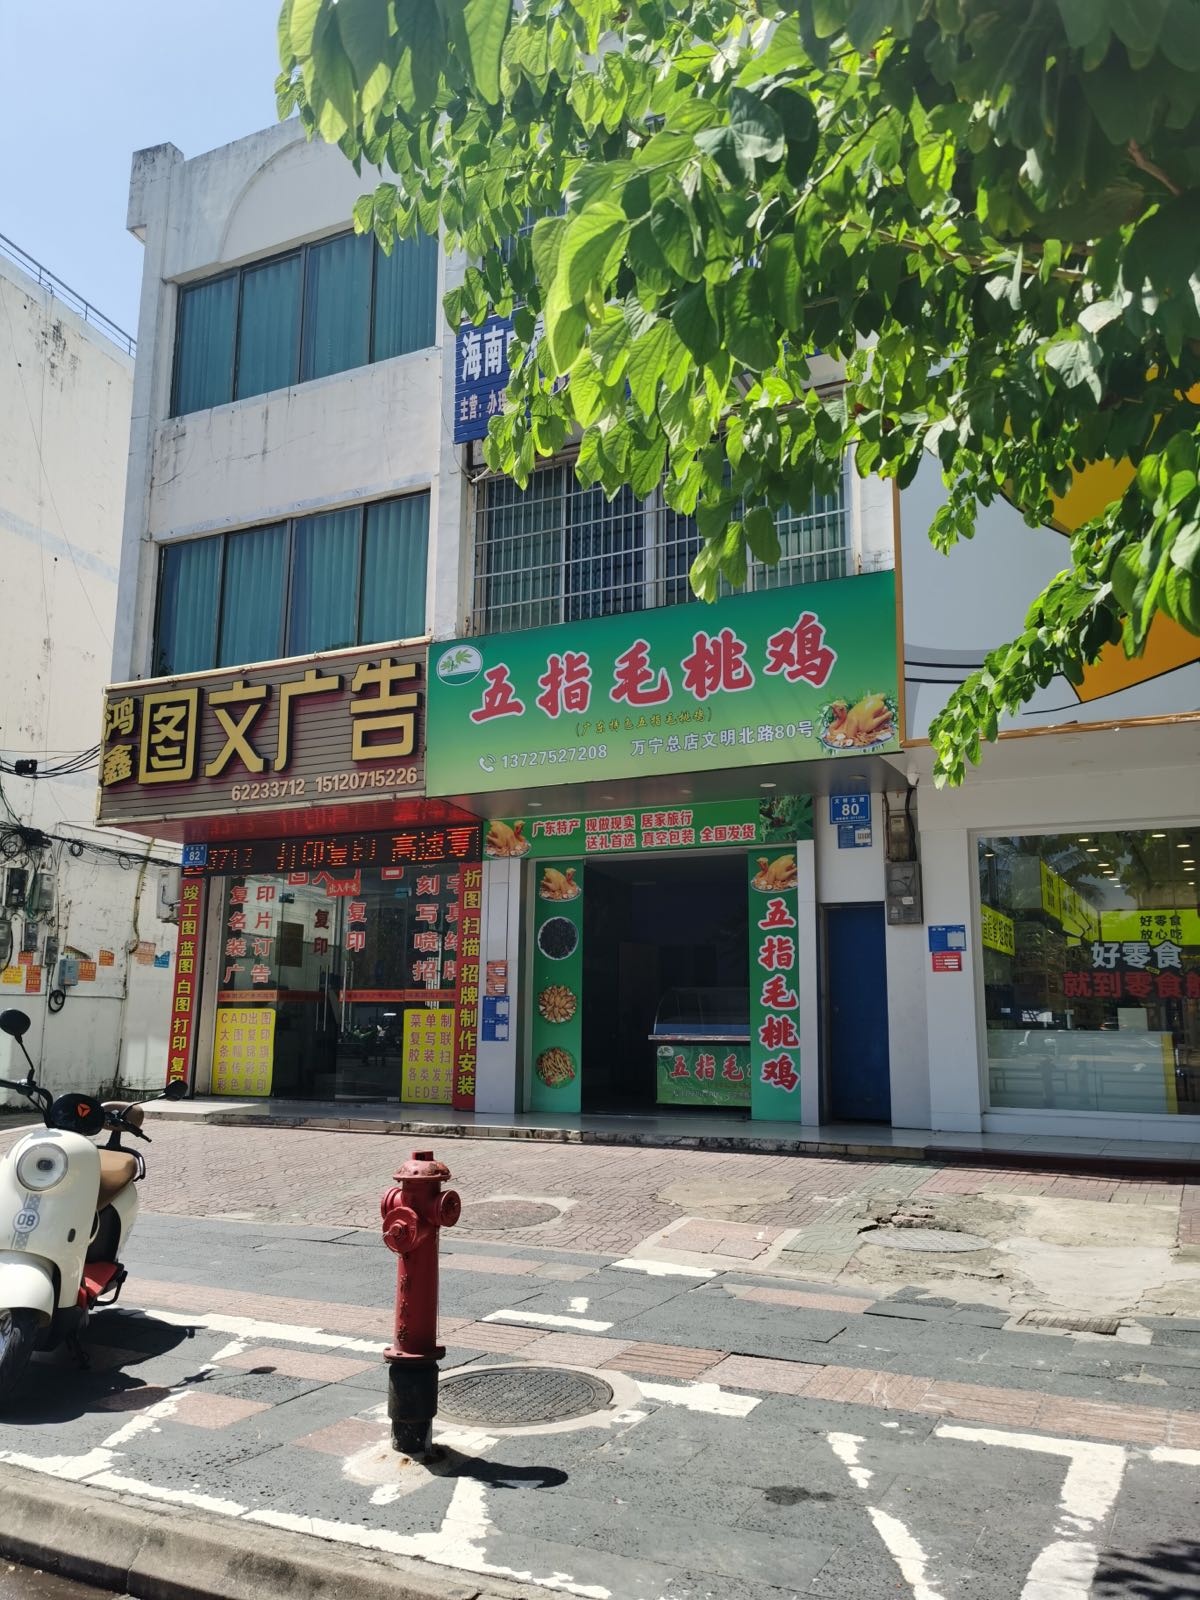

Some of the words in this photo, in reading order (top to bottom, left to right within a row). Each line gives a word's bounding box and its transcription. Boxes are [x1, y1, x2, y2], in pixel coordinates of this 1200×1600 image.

[461, 325, 517, 381] 海南
[470, 610, 838, 725] 五指毛桃鸡
[138, 658, 420, 785] 图文广告
[103, 696, 134, 786] 鸿鑫
[501, 744, 608, 769] 13727527208
[631, 720, 815, 757] 万宁总店文明北路80号
[231, 778, 305, 802] 62233712
[316, 767, 418, 793] 15120715226
[531, 818, 580, 838] 广东特产
[585, 814, 635, 834] 现做现卖
[641, 810, 693, 829] 居家旅行
[841, 803, 859, 816] 80
[586, 832, 636, 850] 送礼首选
[642, 828, 694, 847] 真空包装
[700, 824, 756, 844] 全国发货
[189, 851, 200, 861] 82
[181, 885, 199, 936] 竣工图
[230, 885, 275, 905] 复印
[228, 911, 272, 931] 名片
[346, 902, 367, 952] 复印
[461, 916, 481, 958] 扫描
[1140, 915, 1181, 927] 好零食
[1140, 928, 1183, 940] 放心吃
[178, 941, 194, 974] 蓝图
[225, 937, 273, 957] 装订
[1091, 940, 1183, 970] 好零食
[223, 964, 271, 984] 广告
[175, 980, 191, 1013] 白图
[758, 897, 800, 1092] 五指毛桃鸡
[172, 1017, 189, 1051] 打印
[457, 963, 480, 1096] 招牌制作安装
[670, 1053, 751, 1082] 五指毛
[17, 1213, 35, 1227] 08
